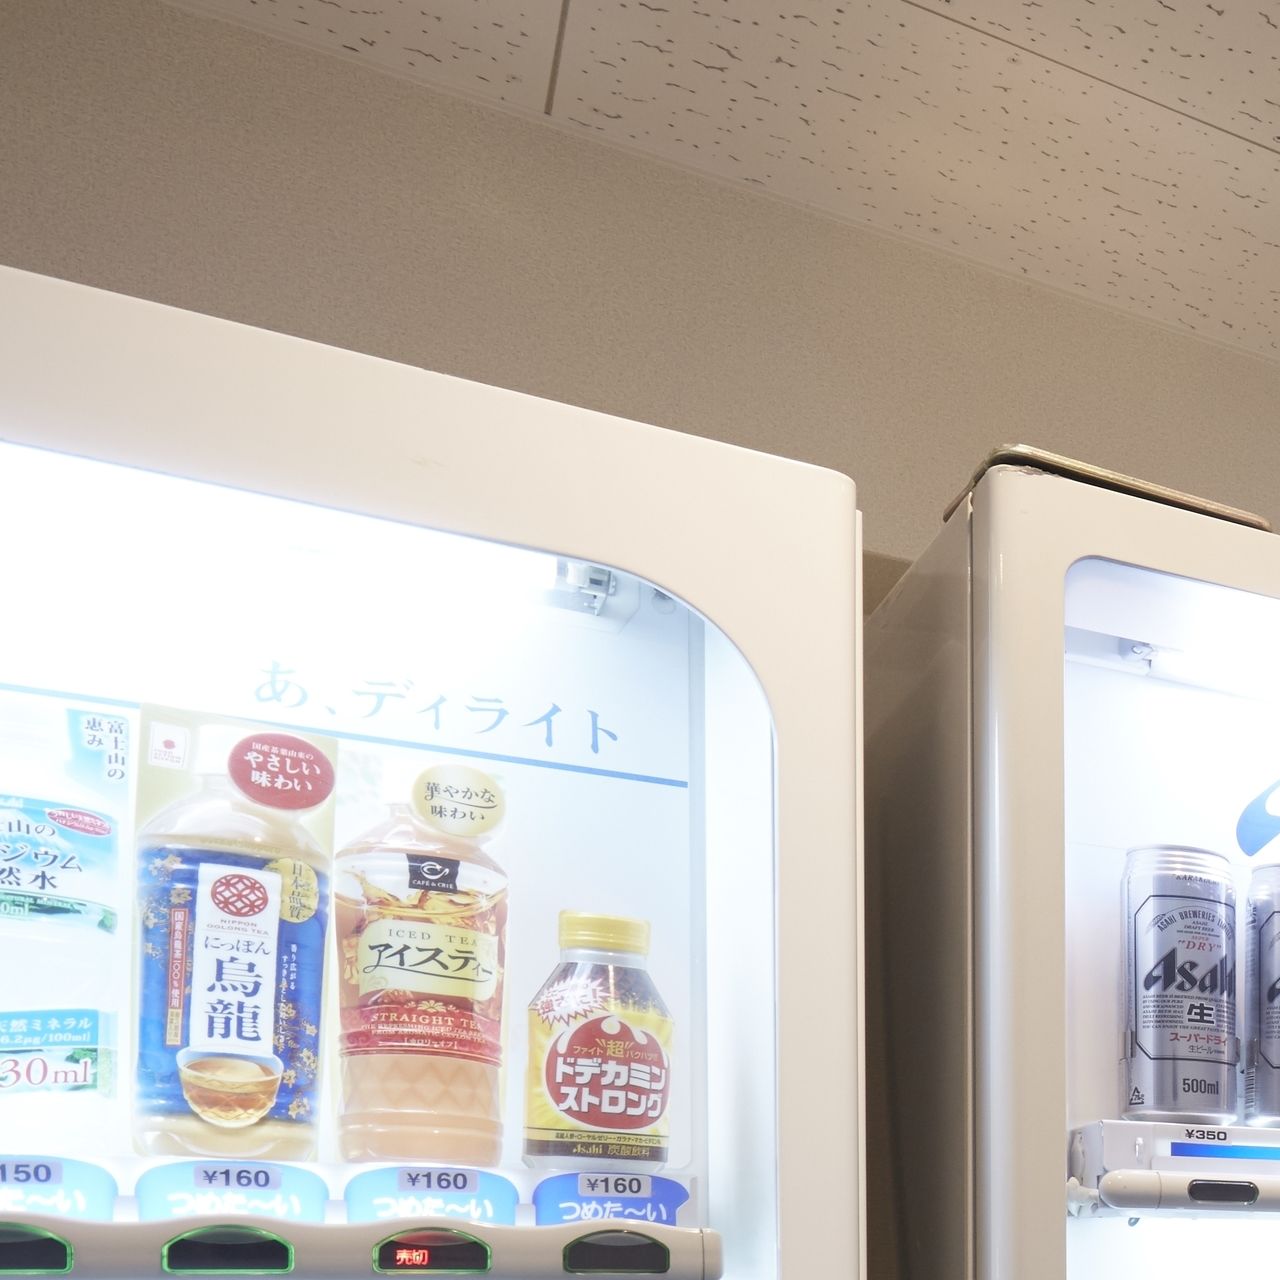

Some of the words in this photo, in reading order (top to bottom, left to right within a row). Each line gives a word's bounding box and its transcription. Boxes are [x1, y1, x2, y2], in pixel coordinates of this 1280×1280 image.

[254, 660, 619, 754] あ、ディライト
[85, 716, 104, 749] 恵み
[107, 720, 126, 781] 富士山の
[244, 749, 322, 776] やさしい
[251, 769, 313, 792] 味わい
[424, 781, 498, 804] 華やかな
[430, 806, 486, 822] 味わい
[389, 928, 431, 941] ICED
[204, 936, 272, 957] にっぽん
[363, 942, 493, 983] アイスティー
[371, 1012, 456, 1027] STRAIGHT
[1186, 1002, 1215, 1025] 生
[606, 1039, 626, 1059] 超
[1169, 1032, 1227, 1047] スーパードライ
[556, 1056, 667, 1092] ドデカミン
[1182, 1077, 1220, 1096] 500ml
[559, 1086, 664, 1118] ストロング
[1185, 1128, 1228, 1142] ¥350
[203, 1169, 270, 1190] ¥160
[407, 1172, 469, 1192] ¥160
[585, 1176, 643, 1196] ¥160
[560, 1199, 669, 1222] つめた〜い
[396, 1248, 428, 1266] 売切
